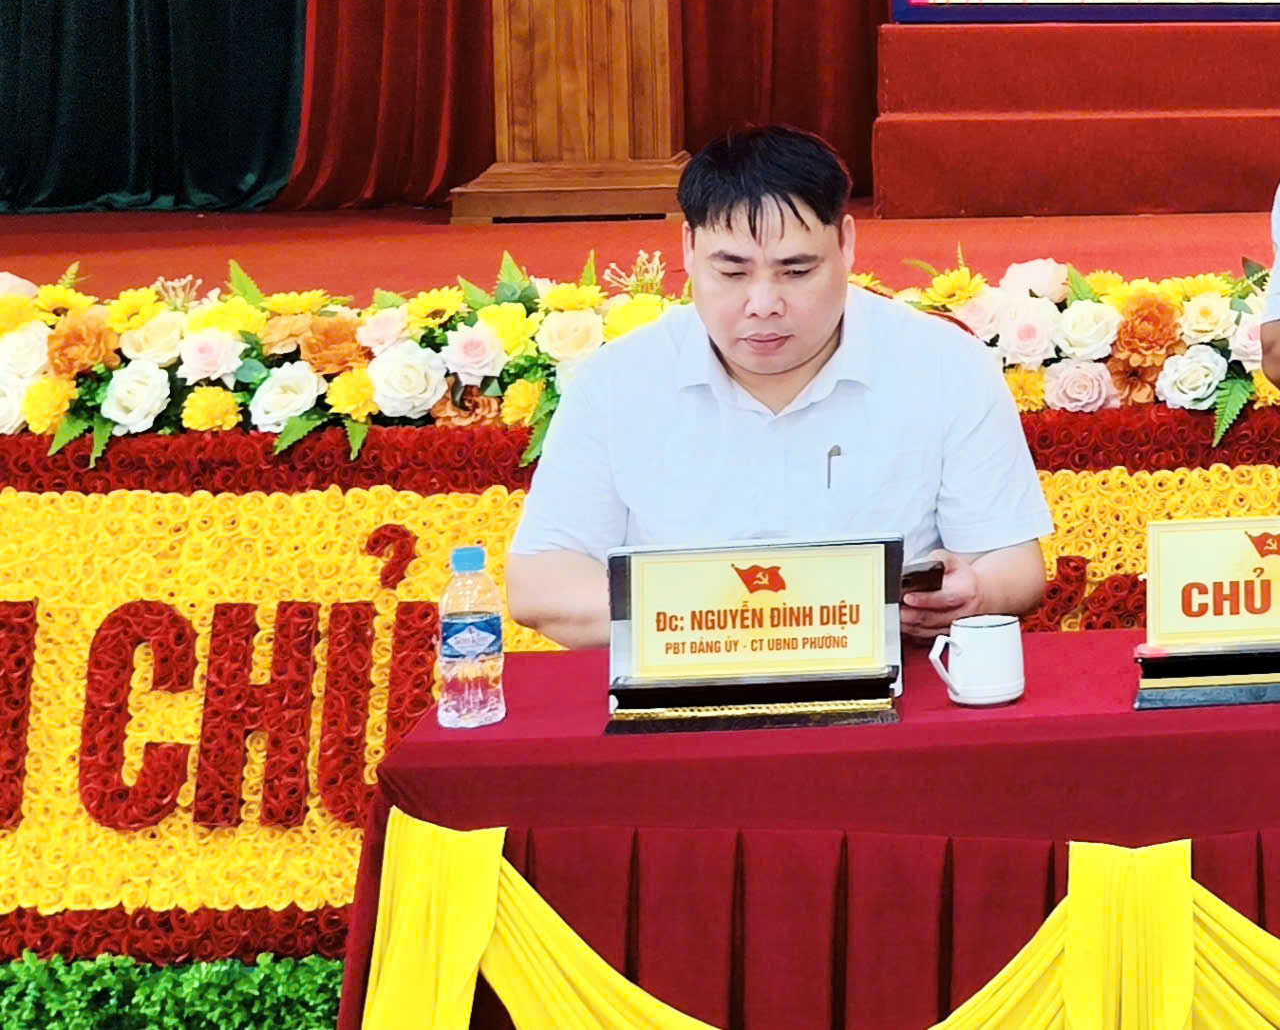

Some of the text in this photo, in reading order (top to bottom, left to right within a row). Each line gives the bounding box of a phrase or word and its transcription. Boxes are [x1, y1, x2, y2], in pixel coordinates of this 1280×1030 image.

[1181, 567, 1272, 618] CHỦ
[691, 601, 764, 631] NGUYỄN
[769, 602, 813, 628] ĐÌNH
[819, 600, 860, 630] DIỆU
